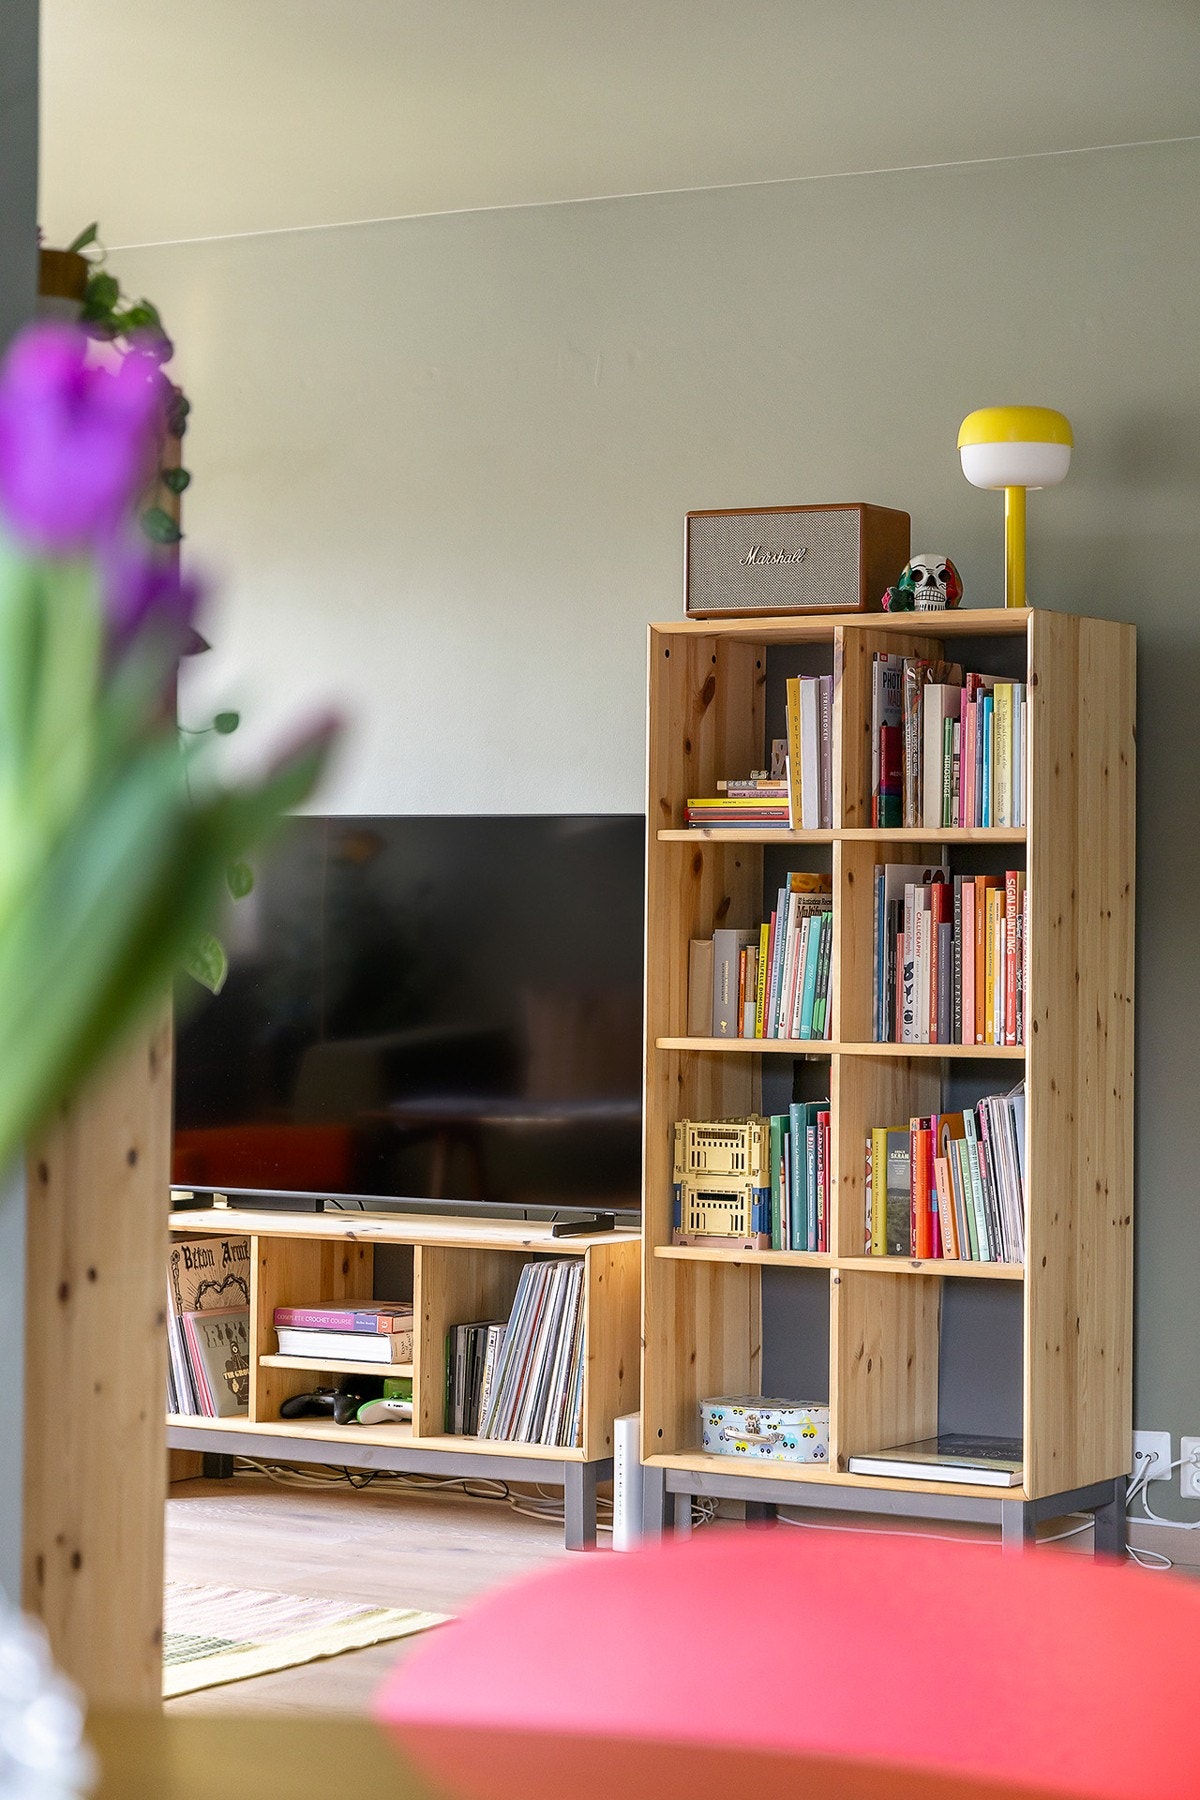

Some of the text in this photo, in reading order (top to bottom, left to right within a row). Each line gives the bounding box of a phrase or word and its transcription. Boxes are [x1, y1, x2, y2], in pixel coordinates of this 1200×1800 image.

[740, 545, 807, 566] Marshall
[944, 754, 952, 798] HIROSHIGE
[1007, 878, 1016, 904] SIGN
[1006, 905, 1016, 955] PAINTING
[277, 1313, 304, 1322] COMPLETE
[330, 1317, 352, 1325] COURSE
[203, 1321, 249, 1348] RIX
